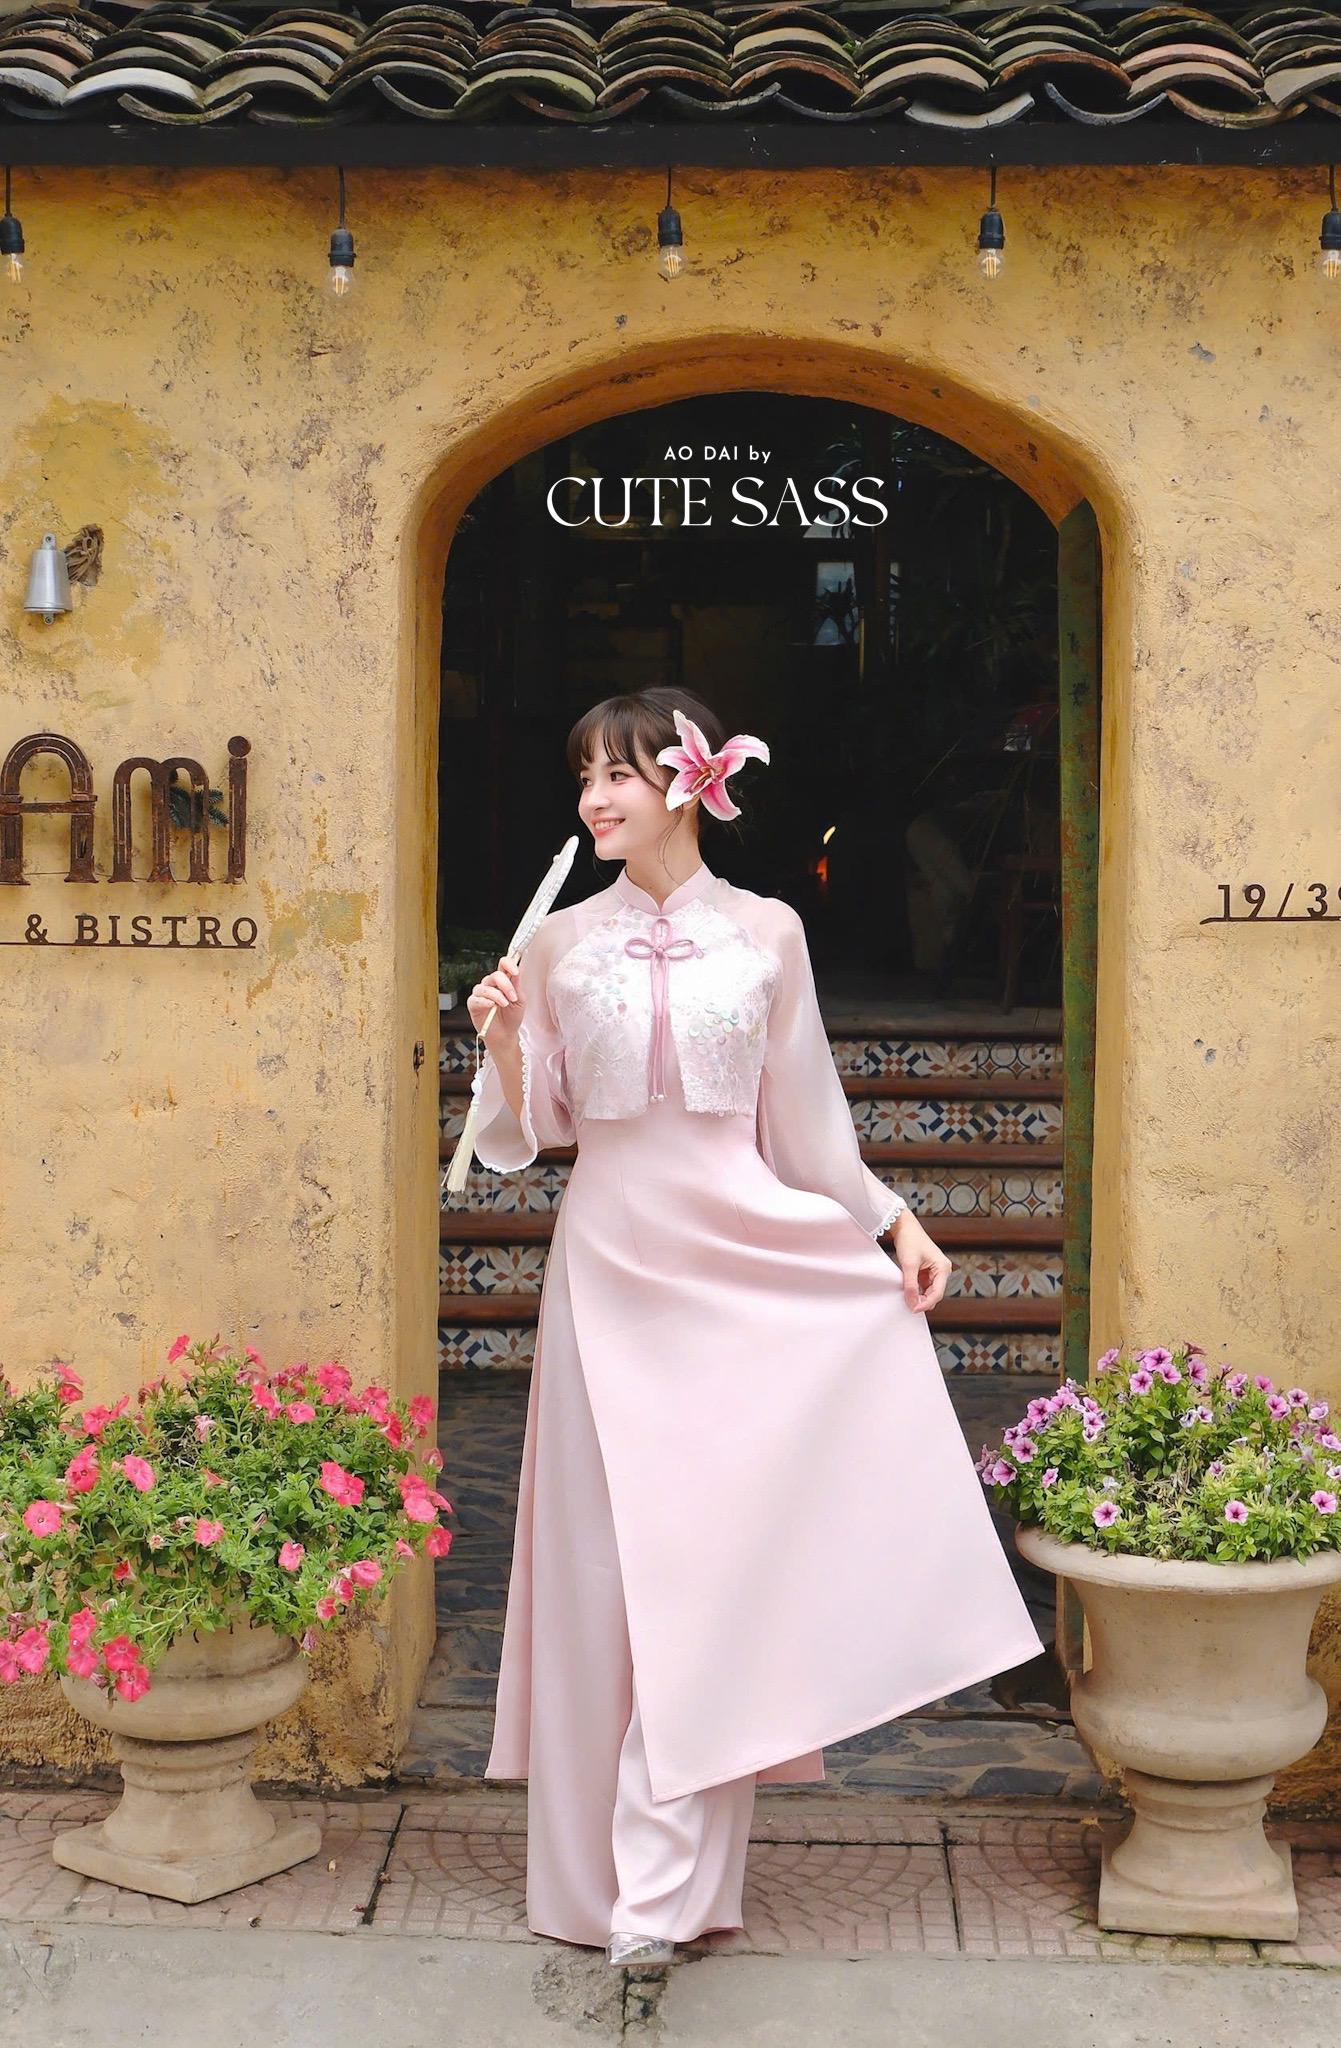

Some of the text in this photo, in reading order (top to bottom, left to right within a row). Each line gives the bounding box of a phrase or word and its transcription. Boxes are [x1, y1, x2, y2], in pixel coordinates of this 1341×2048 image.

[1217, 882, 1341, 920] 19/3
[24, 913, 258, 948] & BISTRO
